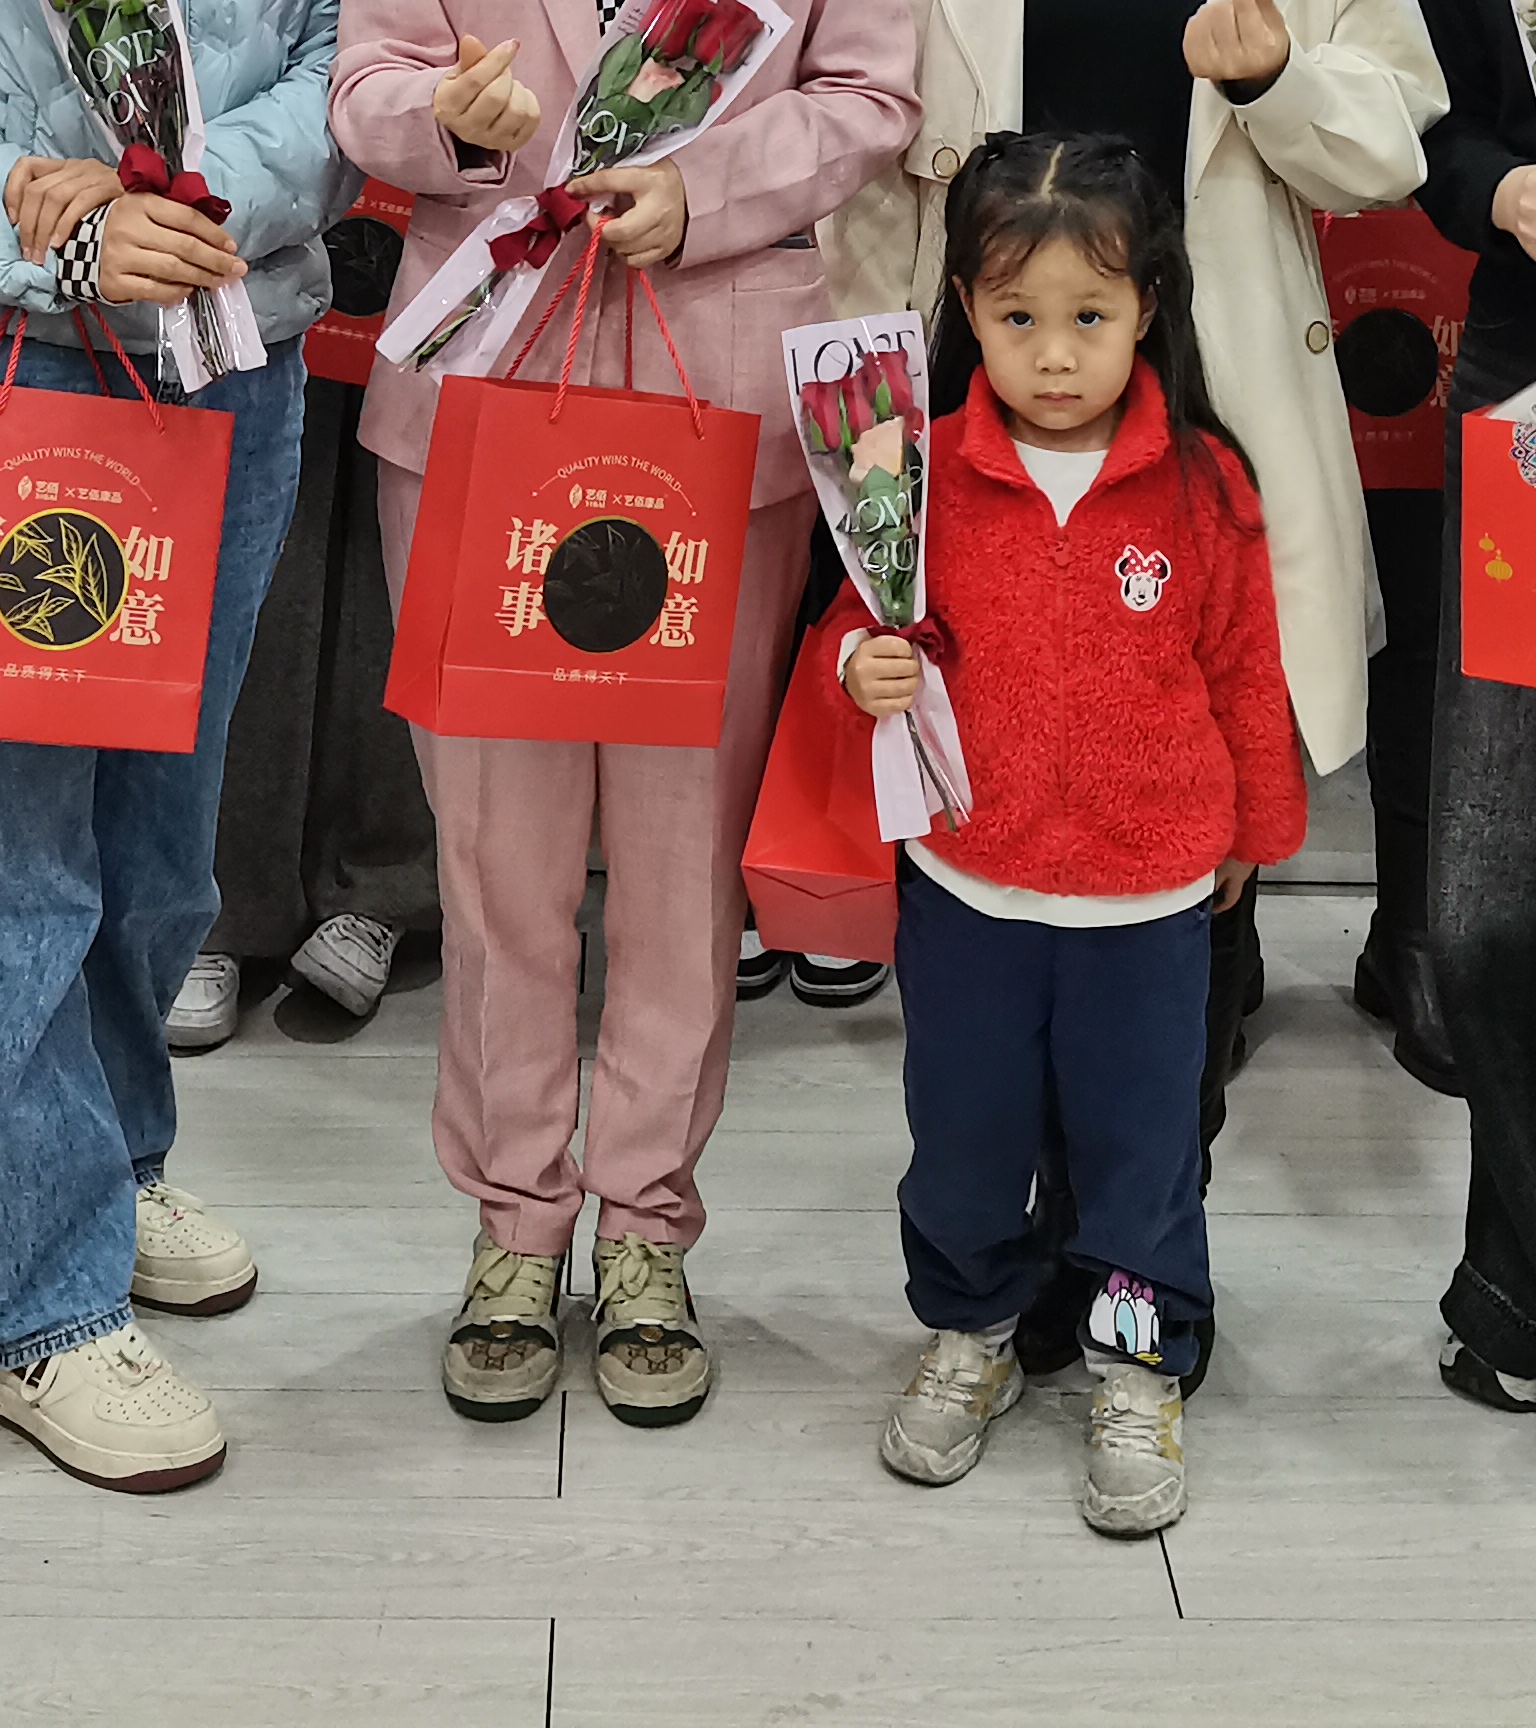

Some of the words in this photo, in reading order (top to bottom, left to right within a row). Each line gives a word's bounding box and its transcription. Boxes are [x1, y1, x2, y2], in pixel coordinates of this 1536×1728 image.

[4, 447, 51, 471] QUALITY
[52, 447, 82, 459] WINS
[83, 449, 106, 465] THE
[105, 457, 141, 486] WORLD
[557, 456, 601, 479] QUALITY
[601, 455, 629, 467] WINS
[630, 456, 651, 473] THE
[650, 465, 683, 492] WORLD
